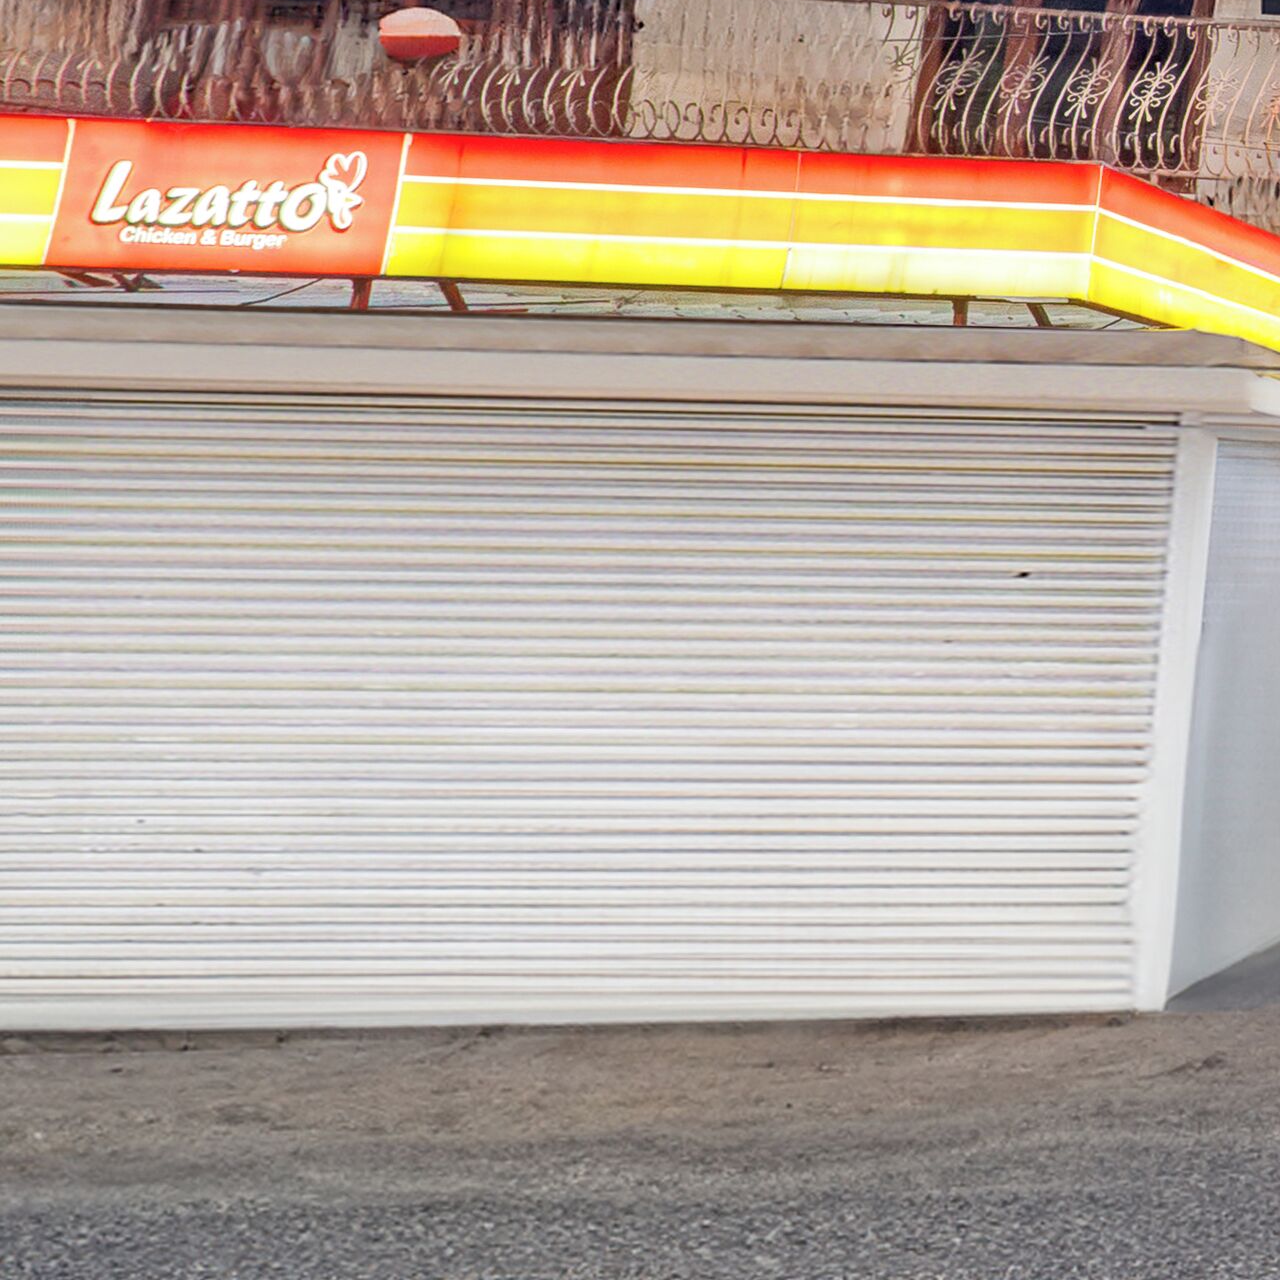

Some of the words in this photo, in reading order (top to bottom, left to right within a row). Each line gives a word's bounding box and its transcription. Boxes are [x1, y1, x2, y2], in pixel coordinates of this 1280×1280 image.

[91, 159, 329, 232] Lazatto
[119, 226, 197, 246] Chicken
[200, 228, 217, 246] &
[219, 228, 288, 250] Burger
